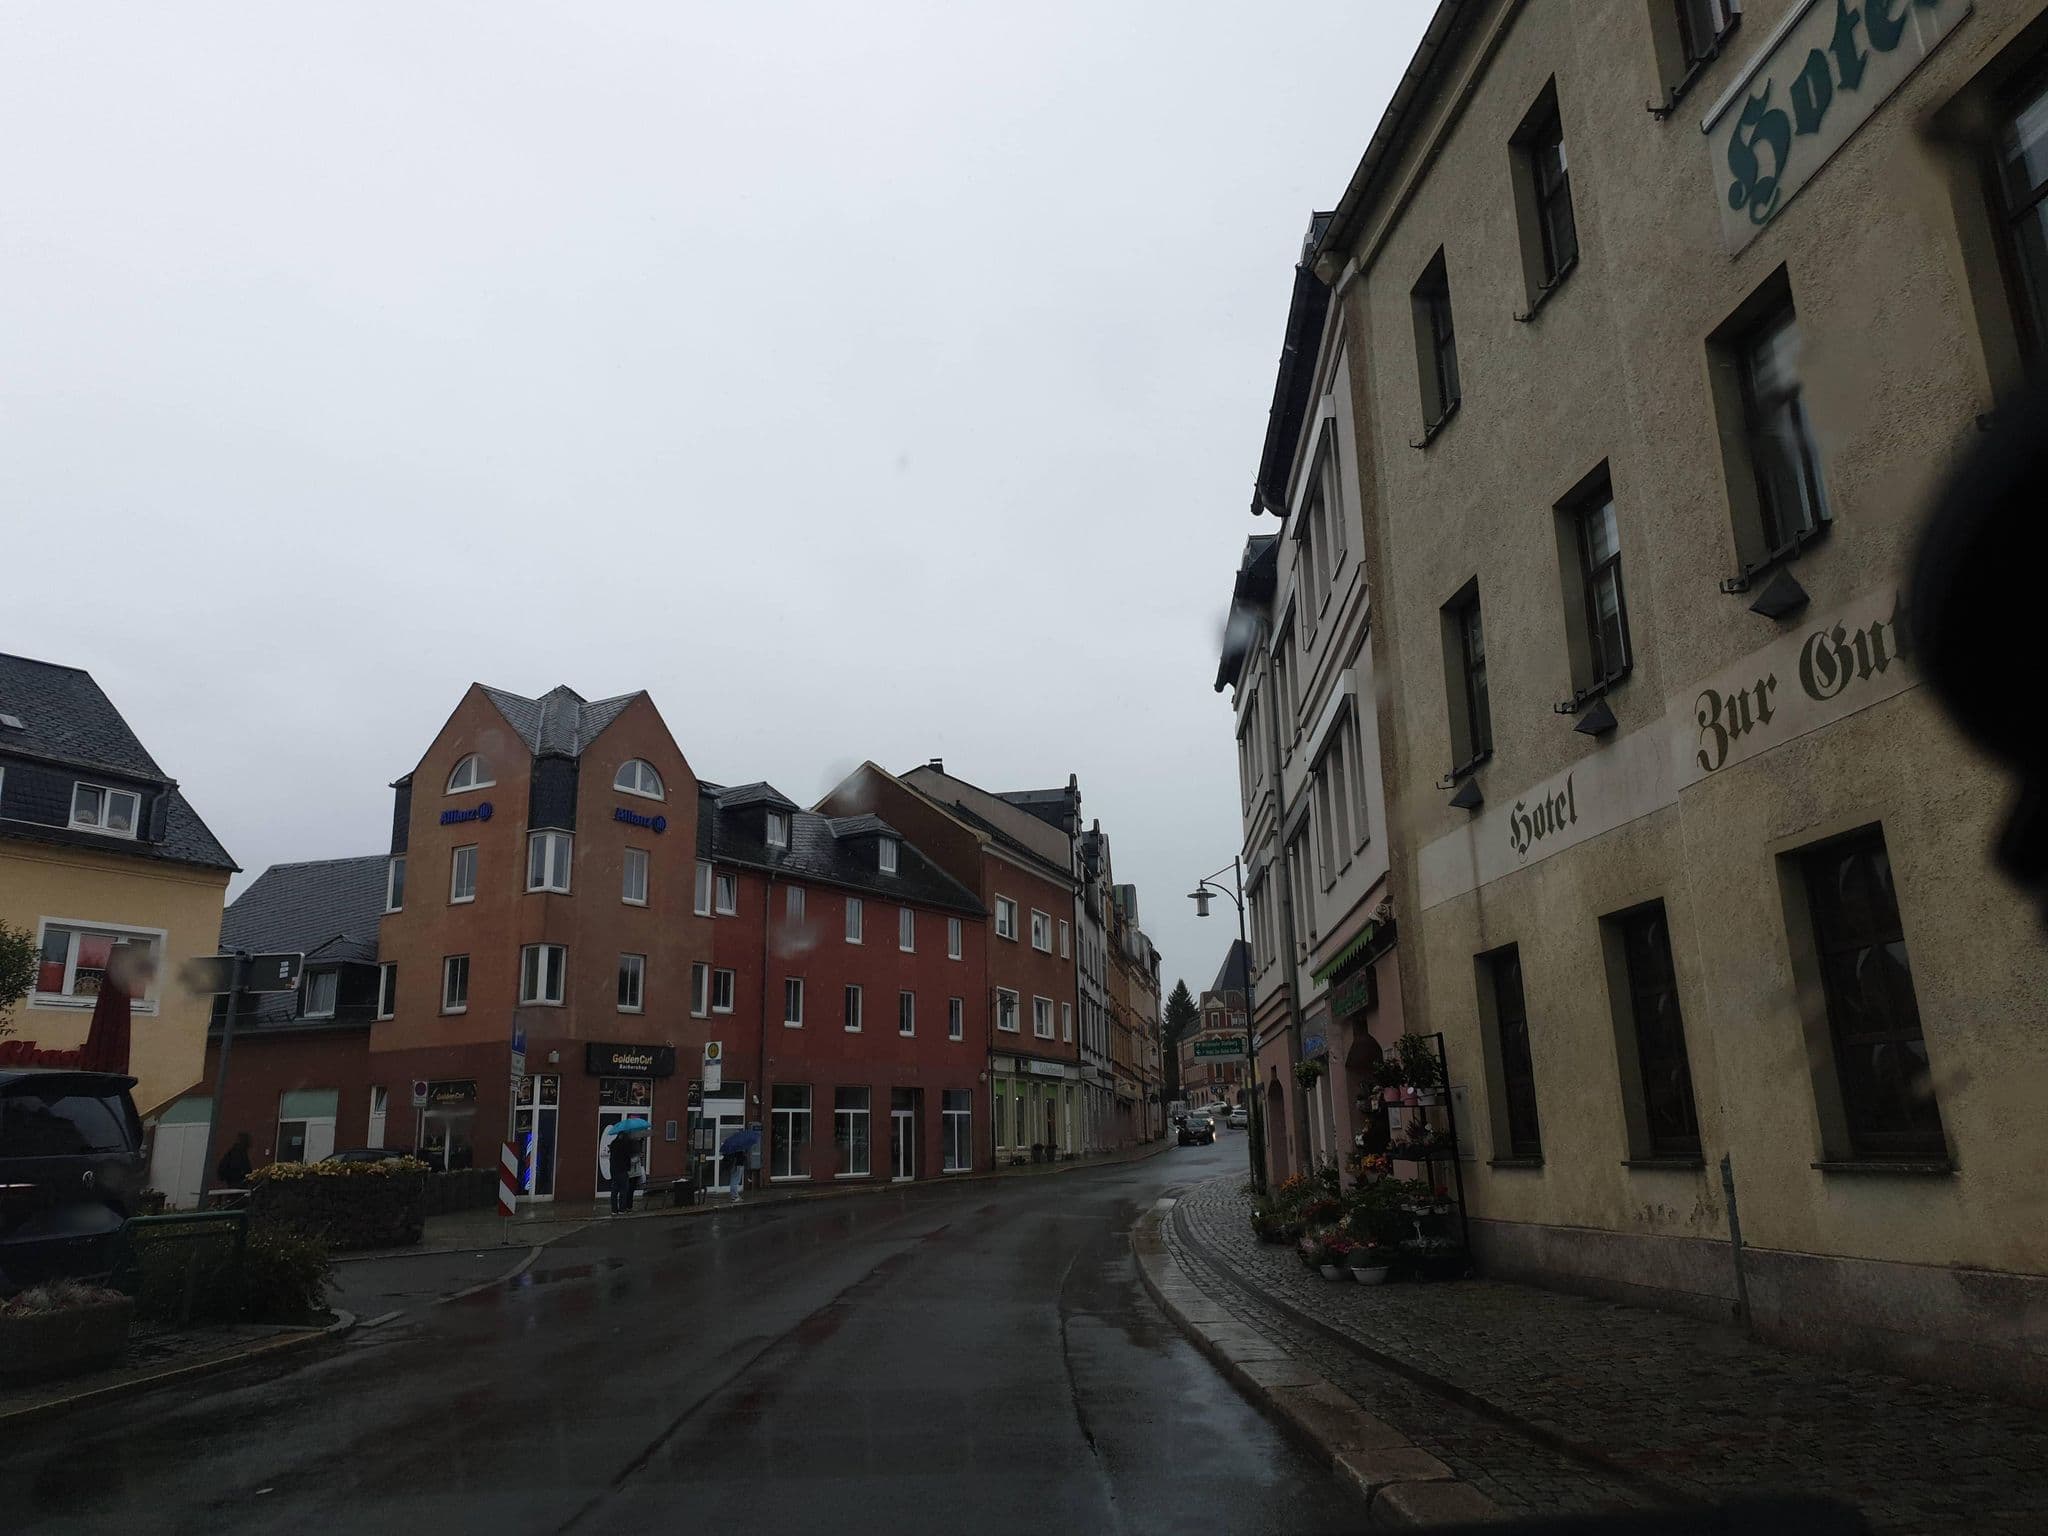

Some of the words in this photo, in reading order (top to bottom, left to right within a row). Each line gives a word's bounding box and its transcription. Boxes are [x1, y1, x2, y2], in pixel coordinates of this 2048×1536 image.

[1696, 672, 1776, 772] Zur
[440, 809, 475, 826] Allianz
[615, 808, 653, 828] Allianz
[1510, 771, 1578, 864] Hotel
